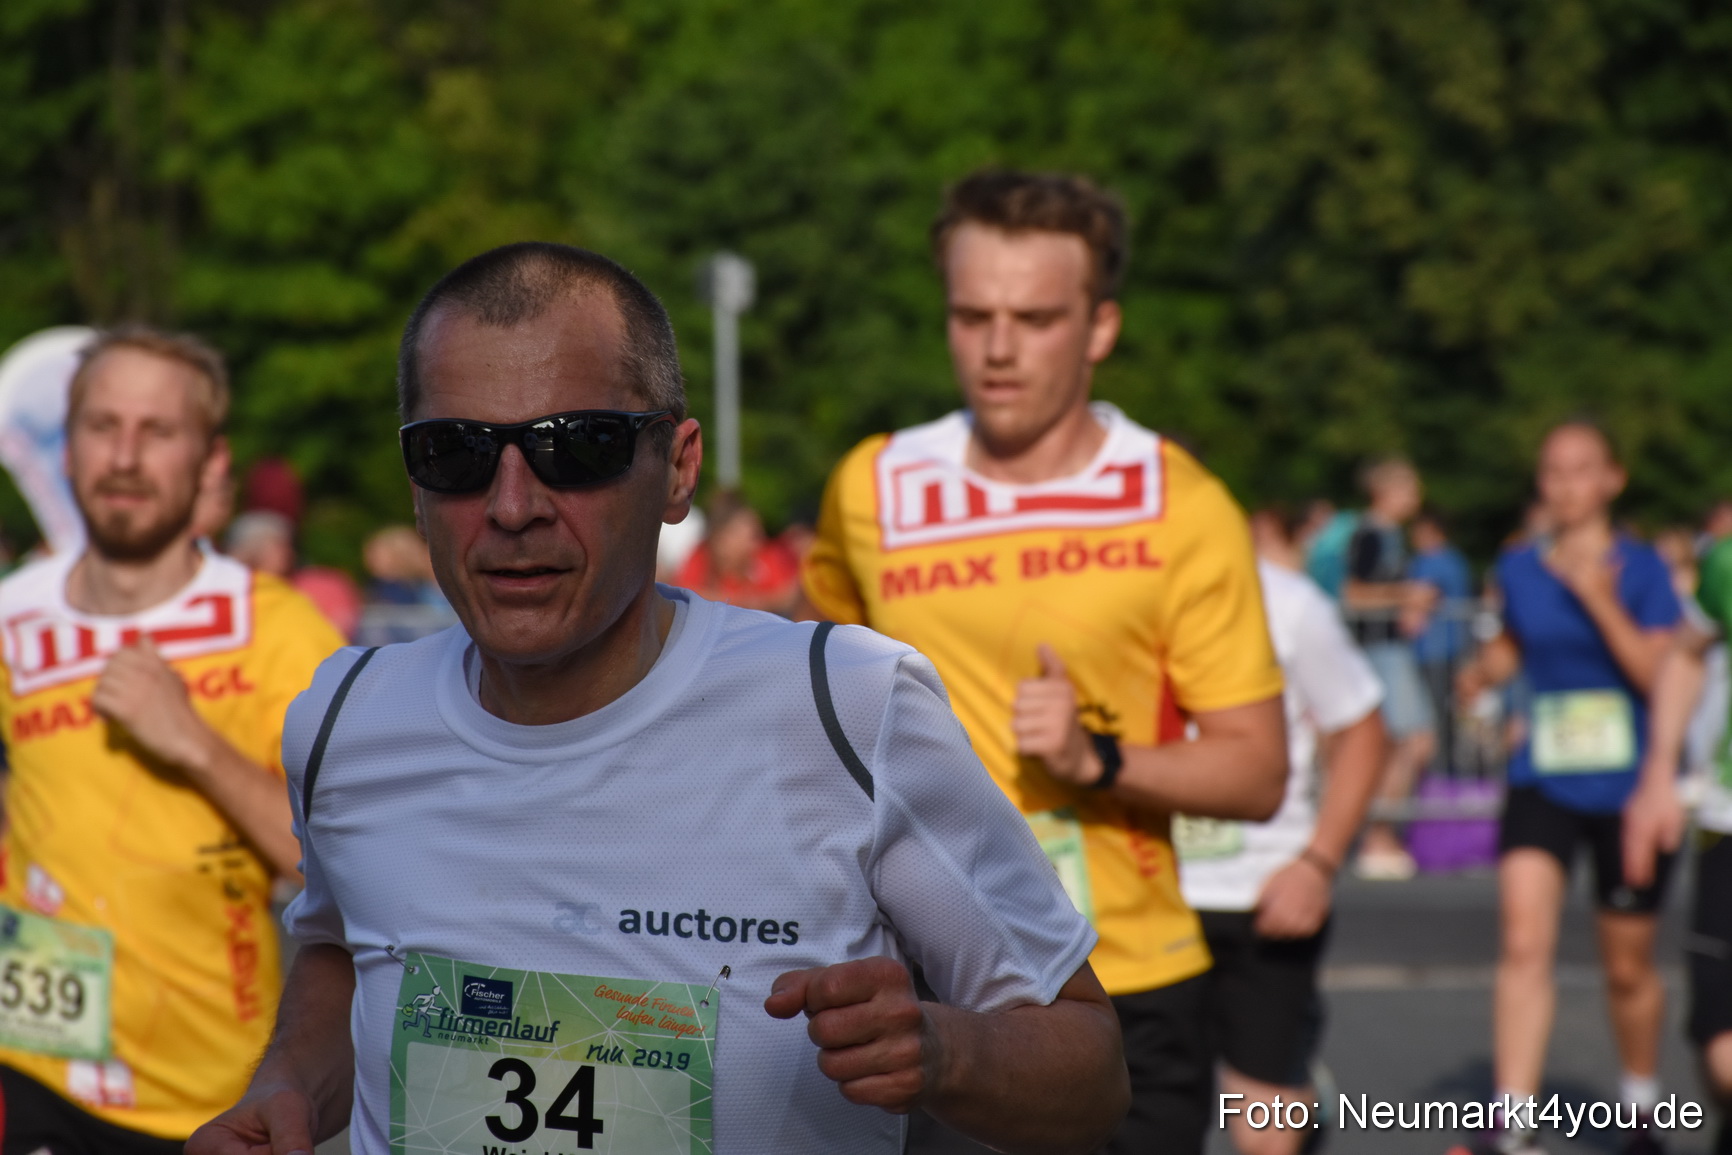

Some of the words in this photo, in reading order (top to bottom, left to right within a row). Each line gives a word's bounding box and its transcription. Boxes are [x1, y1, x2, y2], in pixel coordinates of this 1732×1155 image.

[880, 553, 996, 601] MAX
[1020, 537, 1163, 580] BÖGL
[618, 908, 799, 945] auctores
[1, 960, 85, 1022] 539
[471, 988, 505, 1000] Fischer
[594, 984, 649, 1007] Gesunde
[651, 998, 695, 1018] Firmen
[438, 1032, 489, 1045] neumarkt
[439, 1007, 560, 1043] firmenlauf
[616, 1005, 655, 1025] laufen
[658, 1015, 707, 1039] länger!
[586, 1044, 624, 1064] run
[632, 1049, 690, 1071] 2019
[485, 1057, 603, 1149] 34
